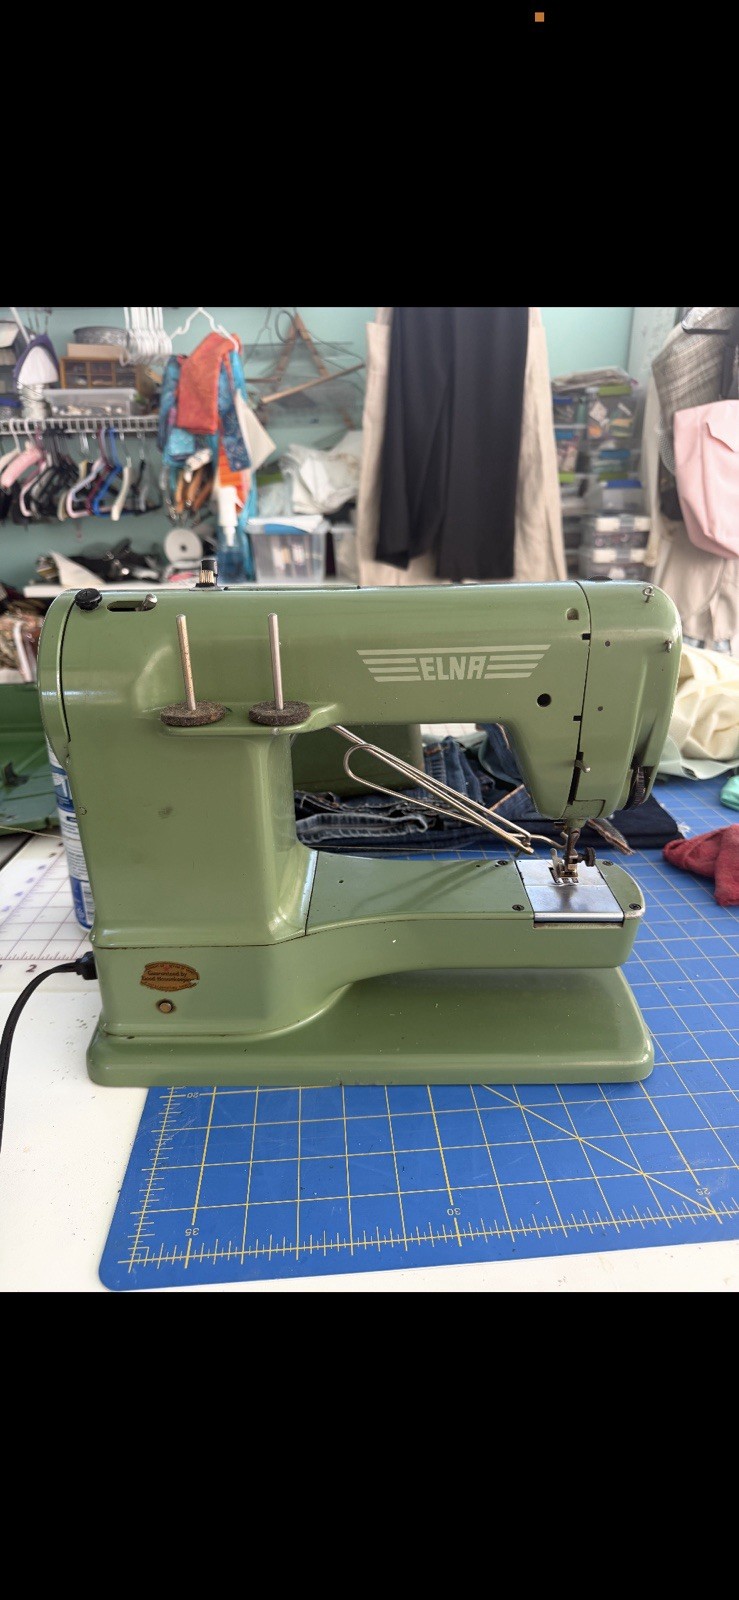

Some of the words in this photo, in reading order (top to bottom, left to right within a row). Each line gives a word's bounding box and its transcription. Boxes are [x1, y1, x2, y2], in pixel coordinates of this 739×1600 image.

[419, 655, 487, 681] ELNA
[26, 964, 37, 973] 2
[186, 1091, 199, 1099] 20
[695, 1187, 711, 1195] 25
[446, 1207, 461, 1216] 30
[184, 1227, 200, 1237] 35
